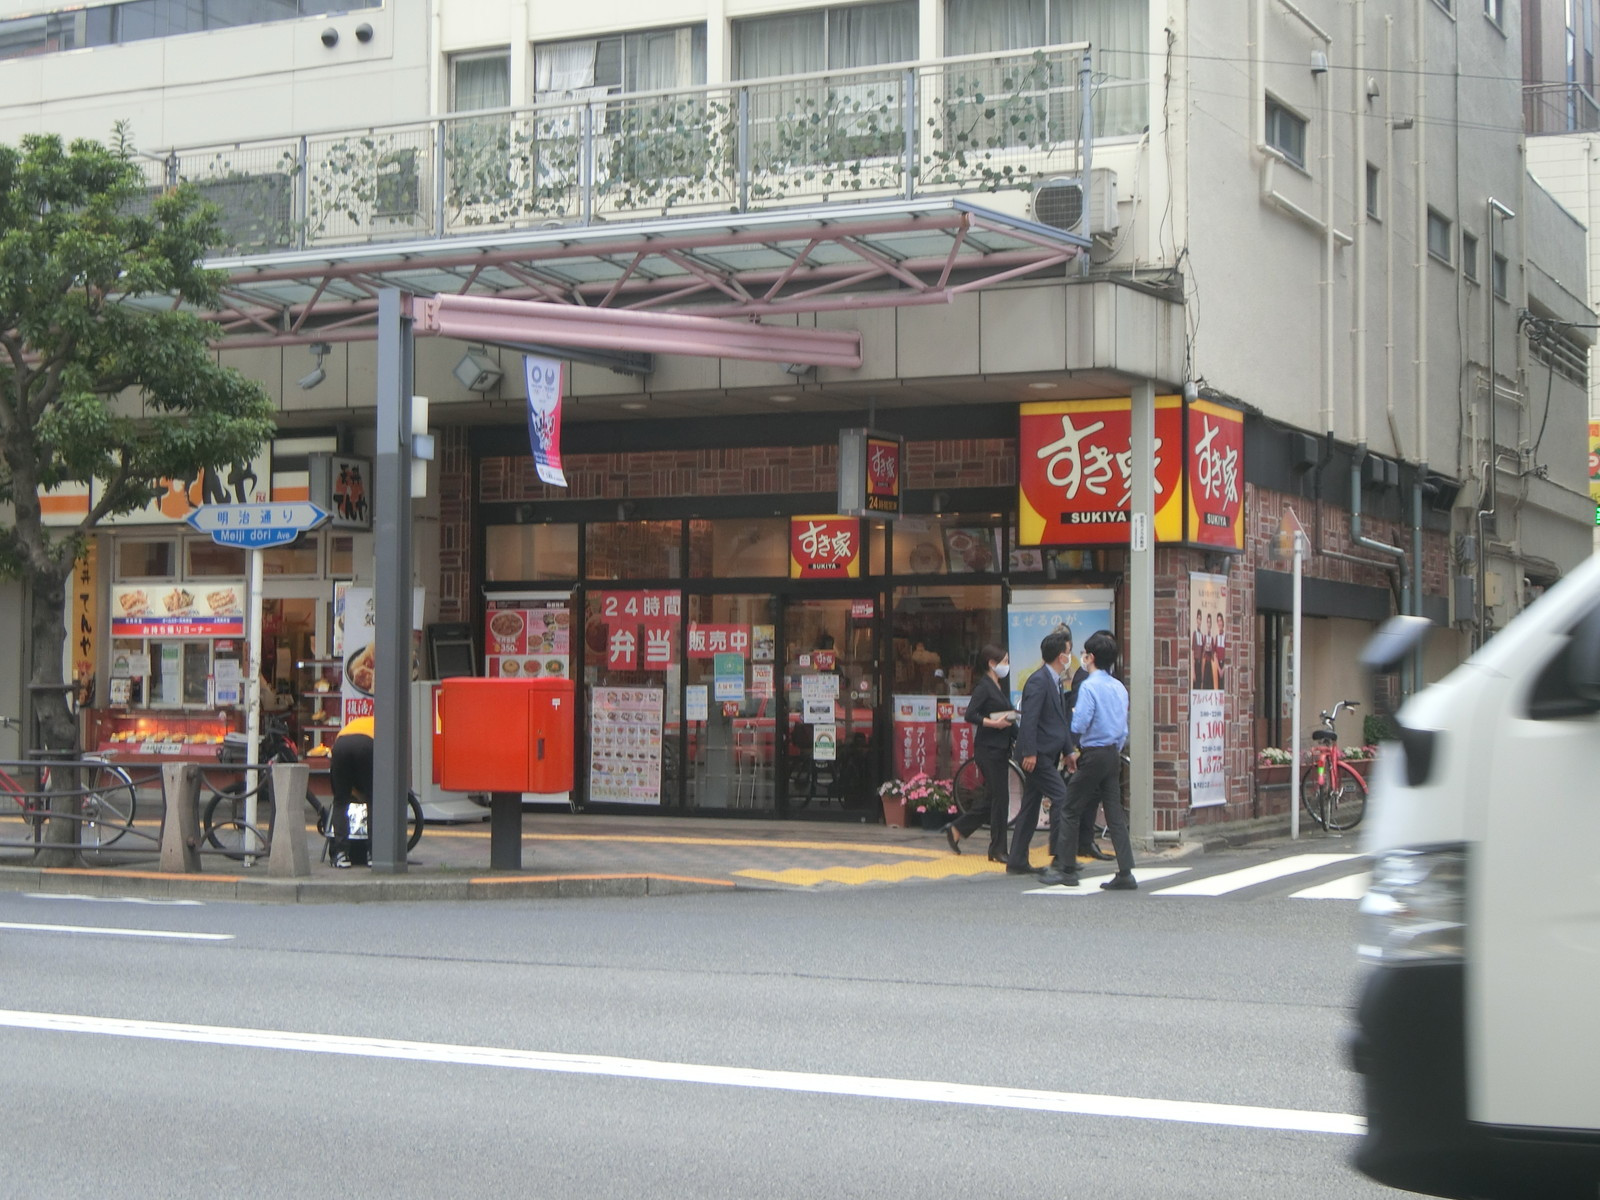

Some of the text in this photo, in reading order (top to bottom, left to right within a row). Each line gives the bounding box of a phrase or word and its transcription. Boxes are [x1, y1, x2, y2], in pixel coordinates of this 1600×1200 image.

[871, 445, 896, 479] すき家
[1195, 415, 1239, 511] すき家
[216, 507, 294, 526] 明治通り
[1071, 510, 1128, 525] SUKIYA
[1206, 514, 1228, 528] SUKIYA
[220, 529, 245, 542] Meiji
[276, 531, 291, 541] Ave
[798, 520, 852, 563] すき家
[811, 562, 838, 570] SUKIYA
[605, 596, 682, 618] 24時間
[79, 594, 92, 658] てんや
[610, 628, 672, 663] 弁当
[688, 629, 748, 652] 販売中
[1196, 720, 1225, 742] 1,100
